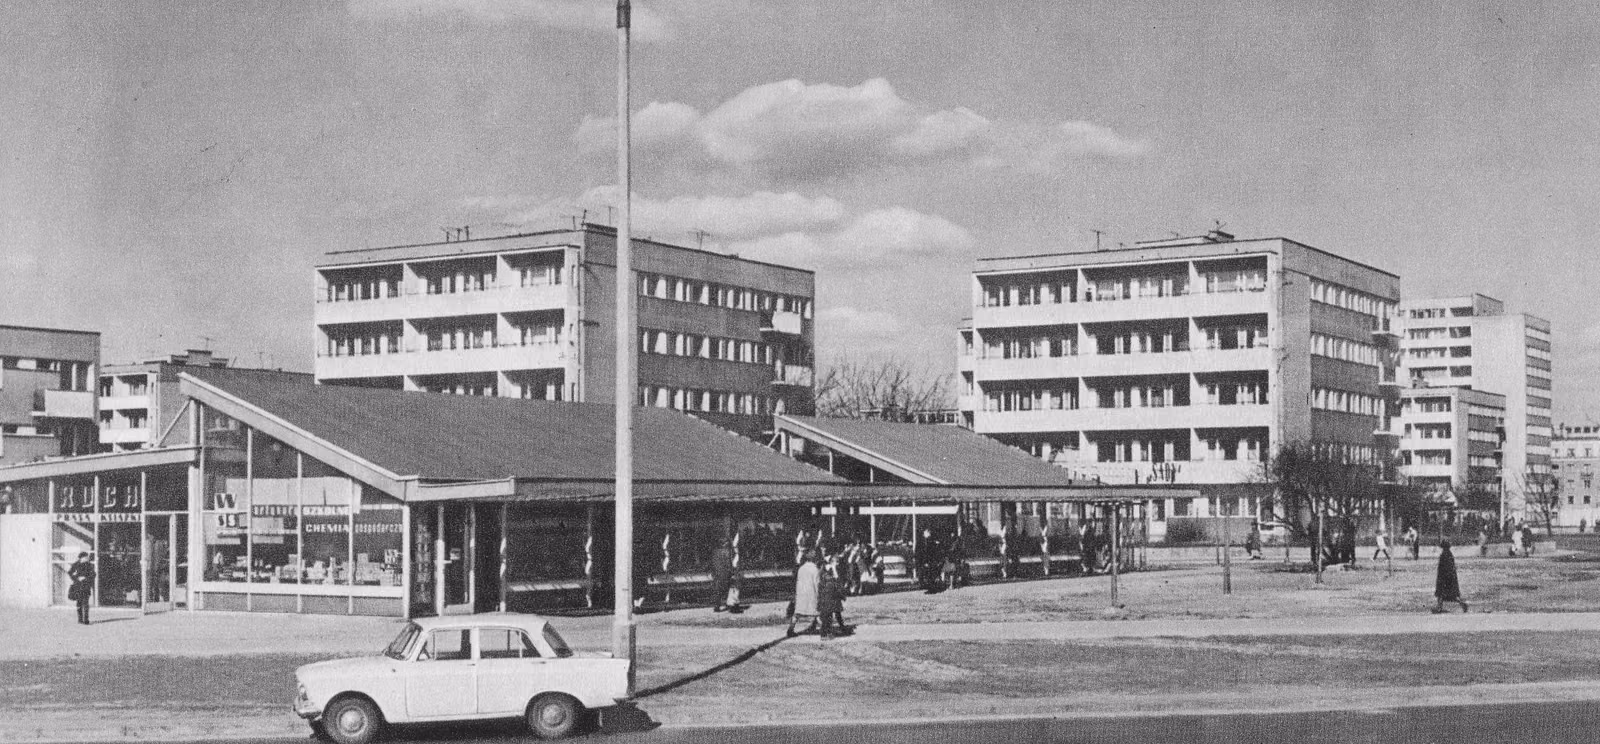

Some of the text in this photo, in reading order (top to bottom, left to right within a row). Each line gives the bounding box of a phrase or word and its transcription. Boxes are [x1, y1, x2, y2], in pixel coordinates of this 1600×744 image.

[61, 486, 138, 508] RUCH
[216, 494, 237, 509] W
[58, 513, 94, 522] PRASA
[306, 523, 350, 533] CHEMIA
